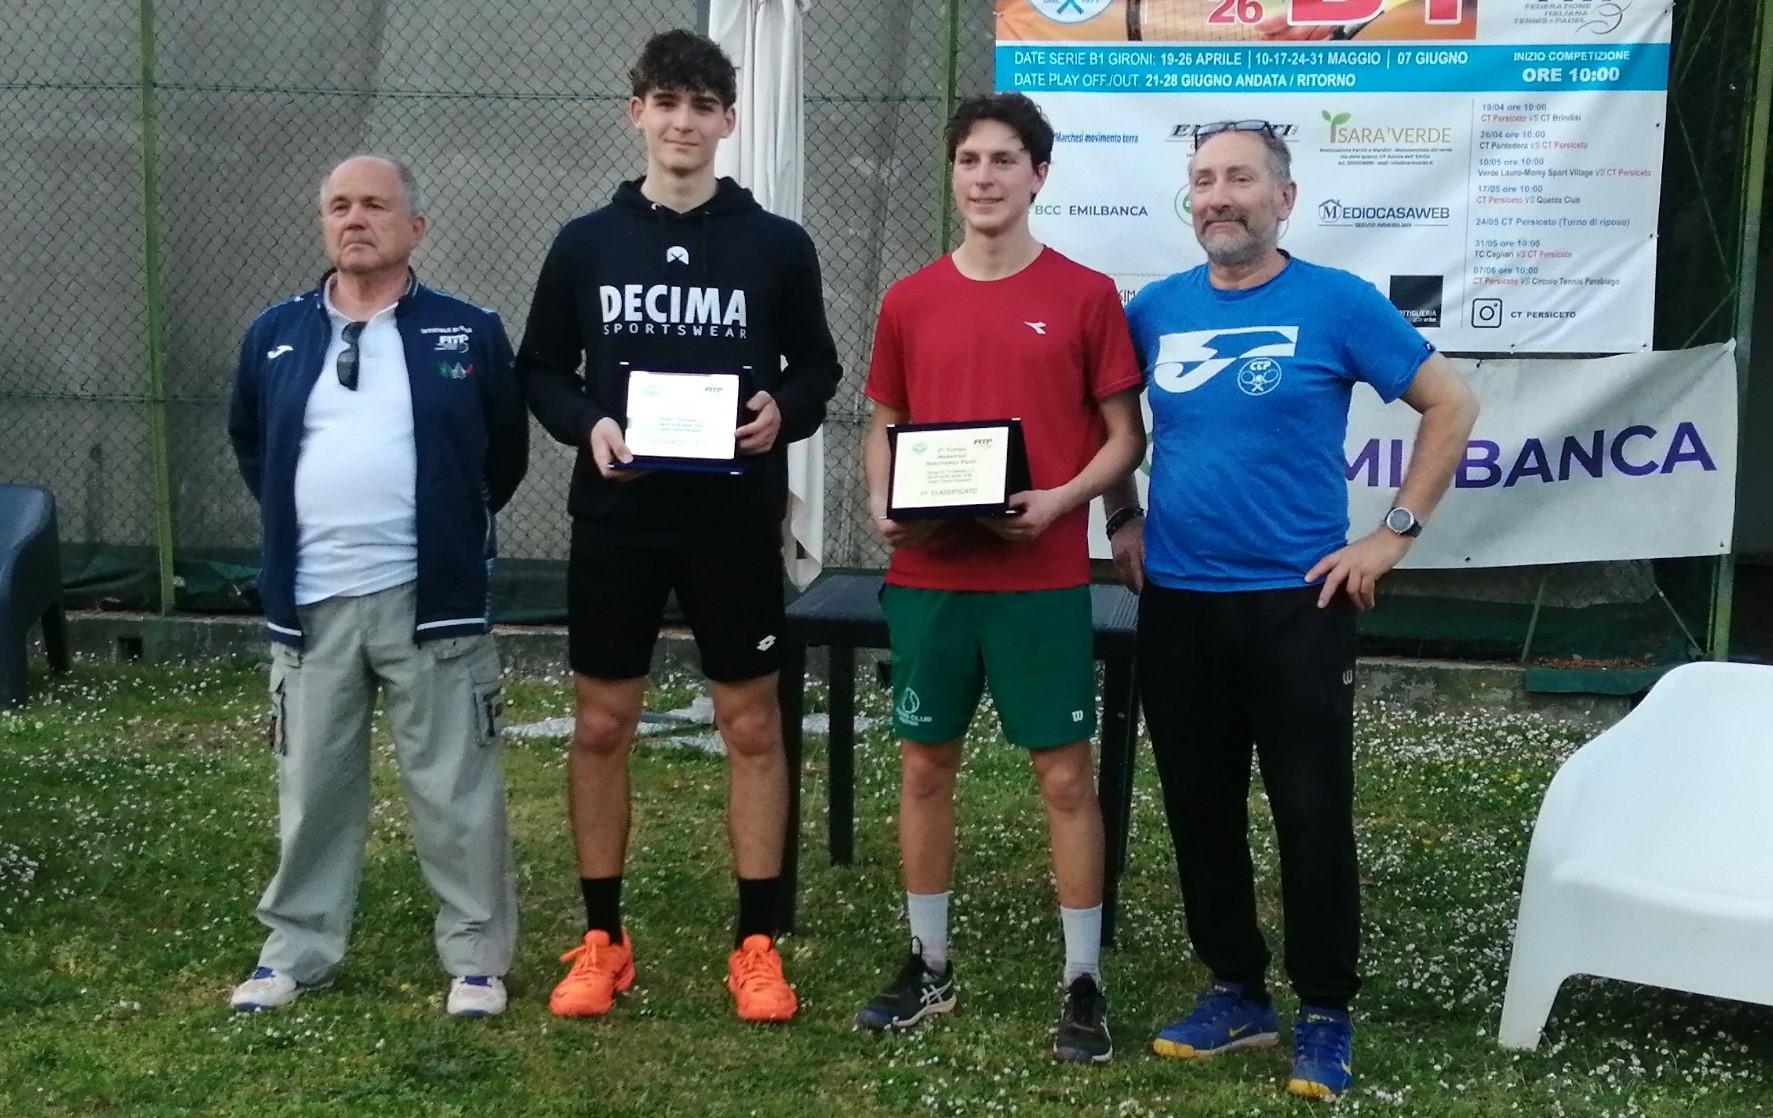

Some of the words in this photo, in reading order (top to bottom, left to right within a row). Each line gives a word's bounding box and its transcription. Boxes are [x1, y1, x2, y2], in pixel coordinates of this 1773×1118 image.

[1014, 51, 1045, 65] DATE
[1049, 52, 1085, 65] SERIE
[1089, 52, 1104, 65] B1
[1161, 53, 1193, 66] 19-26
[1195, 53, 1242, 66] APRILE
[1255, 53, 1324, 66] 10-17-24-31
[1327, 53, 1381, 66] MAGGIO
[1397, 53, 1413, 65] 07
[1416, 53, 1468, 65] GIUGNO
[1514, 51, 1546, 62] INIZIO
[1548, 51, 1631, 62] COMPETIZIONE
[1014, 73, 1045, 86] DATE
[1049, 73, 1079, 86] PLAY
[1145, 74, 1178, 87] 21-28
[1181, 74, 1232, 87] GIUGNO
[1236, 74, 1287, 87] ANDATA
[1297, 74, 1356, 87] RITORNO
[1522, 68, 1562, 83] ORE
[1569, 67, 1620, 82] 10:00
[1507, 103, 1521, 112] ore
[1524, 103, 1547, 112] 10:00
[1540, 114, 1551, 123] CT
[1084, 133, 1122, 143] movimento
[1505, 130, 1520, 139] ore
[1479, 141, 1490, 150] CT
[1503, 158, 1518, 166] ore
[1521, 158, 1545, 166] 10:00
[1547, 169, 1569, 178] Sport
[1569, 169, 1594, 178] Village
[1607, 169, 1617, 177] CT
[1502, 185, 1517, 193] ore
[1520, 185, 1543, 193] 10:00
[1035, 204, 1062, 216] BCC
[1069, 205, 1148, 216] EMILBANCA
[1501, 218, 1514, 226] CT
[1516, 218, 1557, 226] Persiceto
[1558, 217, 1587, 227] (Turno
[1589, 218, 1598, 226] di
[1599, 217, 1630, 227] riposo)
[1500, 239, 1515, 248] ore
[1474, 250, 1485, 258] TC
[1527, 250, 1538, 258] CT
[1498, 266, 1513, 275] ore
[600, 284, 747, 327] DECIMA
[1510, 311, 1523, 319] CT
[1526, 311, 1577, 319] PERSICETO
[603, 323, 747, 339] SPORTSWEAR
[1345, 421, 1717, 489] MIBANCA
